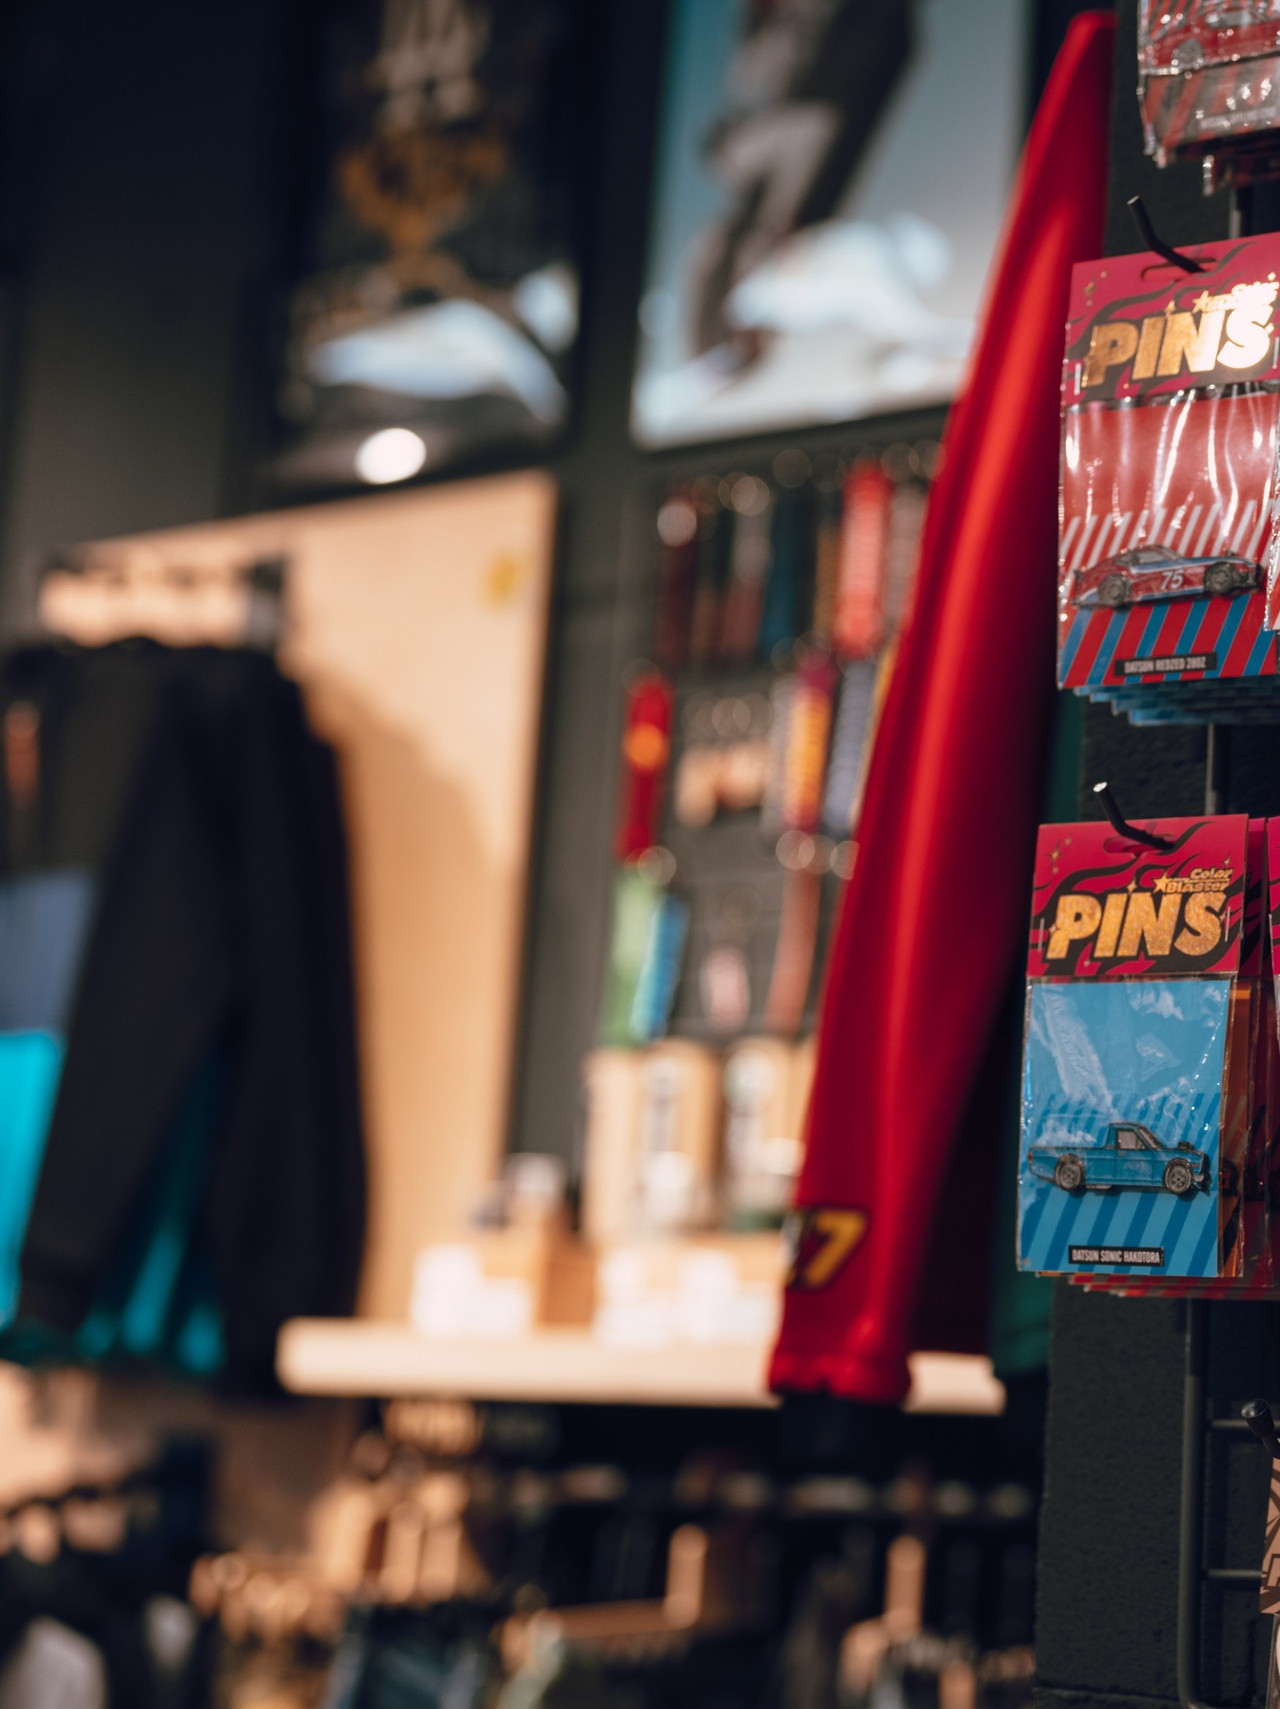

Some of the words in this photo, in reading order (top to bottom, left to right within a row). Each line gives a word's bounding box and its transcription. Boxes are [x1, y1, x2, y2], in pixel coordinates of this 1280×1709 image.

[1081, 304, 1275, 388] PINS
[1161, 569, 1185, 590] 75
[1124, 661, 1155, 675] DATSUN
[1190, 867, 1234, 881] Color
[1166, 880, 1231, 894] Blaster
[1046, 892, 1227, 960] PINS
[1071, 1249, 1100, 1262] DATSUN
[1100, 1250, 1123, 1263] SONIC
[1123, 1251, 1161, 1264] HAKOTORA
